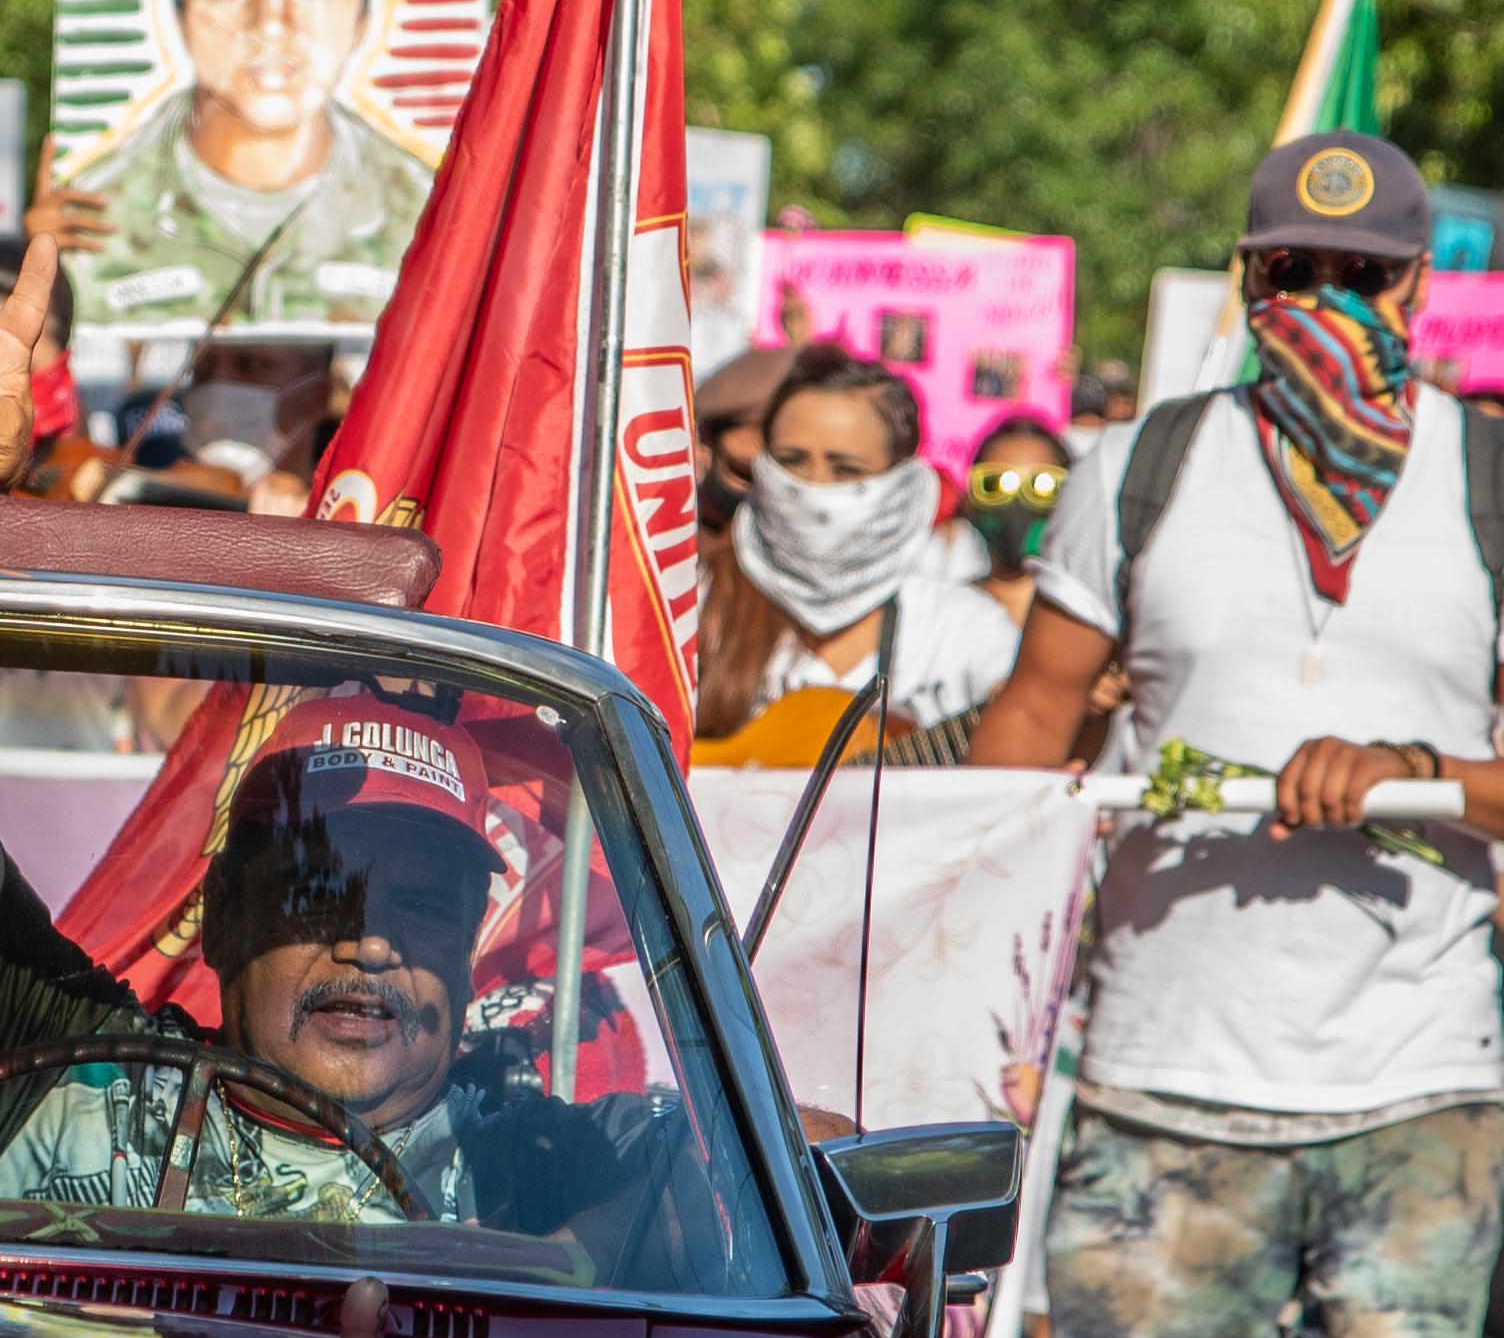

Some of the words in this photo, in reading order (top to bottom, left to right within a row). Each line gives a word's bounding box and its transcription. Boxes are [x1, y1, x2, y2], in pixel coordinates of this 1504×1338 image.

[313, 753, 372, 769] BODY
[383, 756, 396, 769] &
[406, 761, 461, 792] PAINT
[342, 721, 461, 780] COLUNGA
